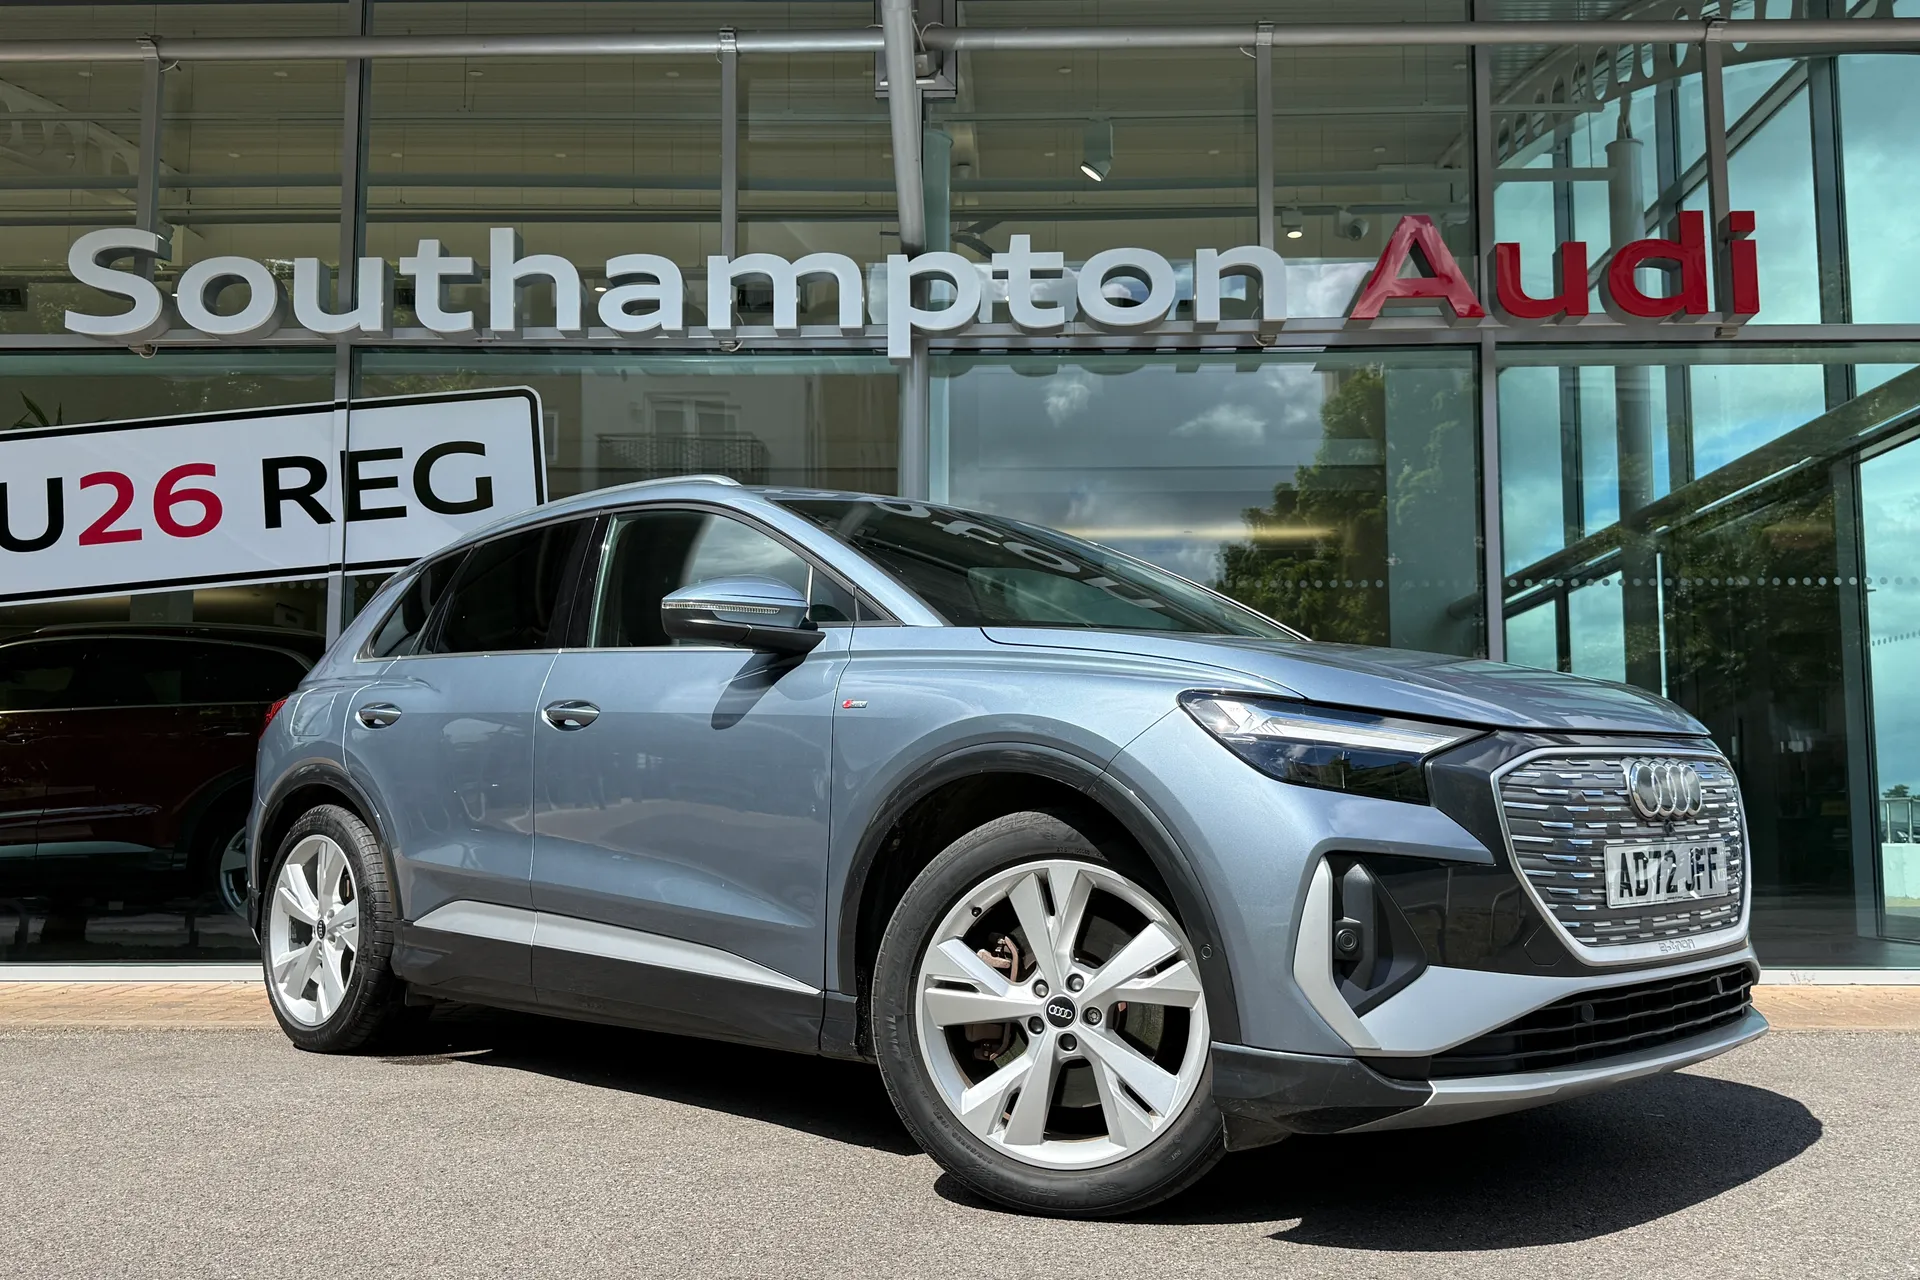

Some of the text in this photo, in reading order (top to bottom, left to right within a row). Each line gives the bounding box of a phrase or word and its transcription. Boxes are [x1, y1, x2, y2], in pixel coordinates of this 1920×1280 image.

[64, 210, 1760, 358] Southampton Audi
[262, 441, 494, 528] REG
[1619, 847, 1718, 898] AD72 JFF
